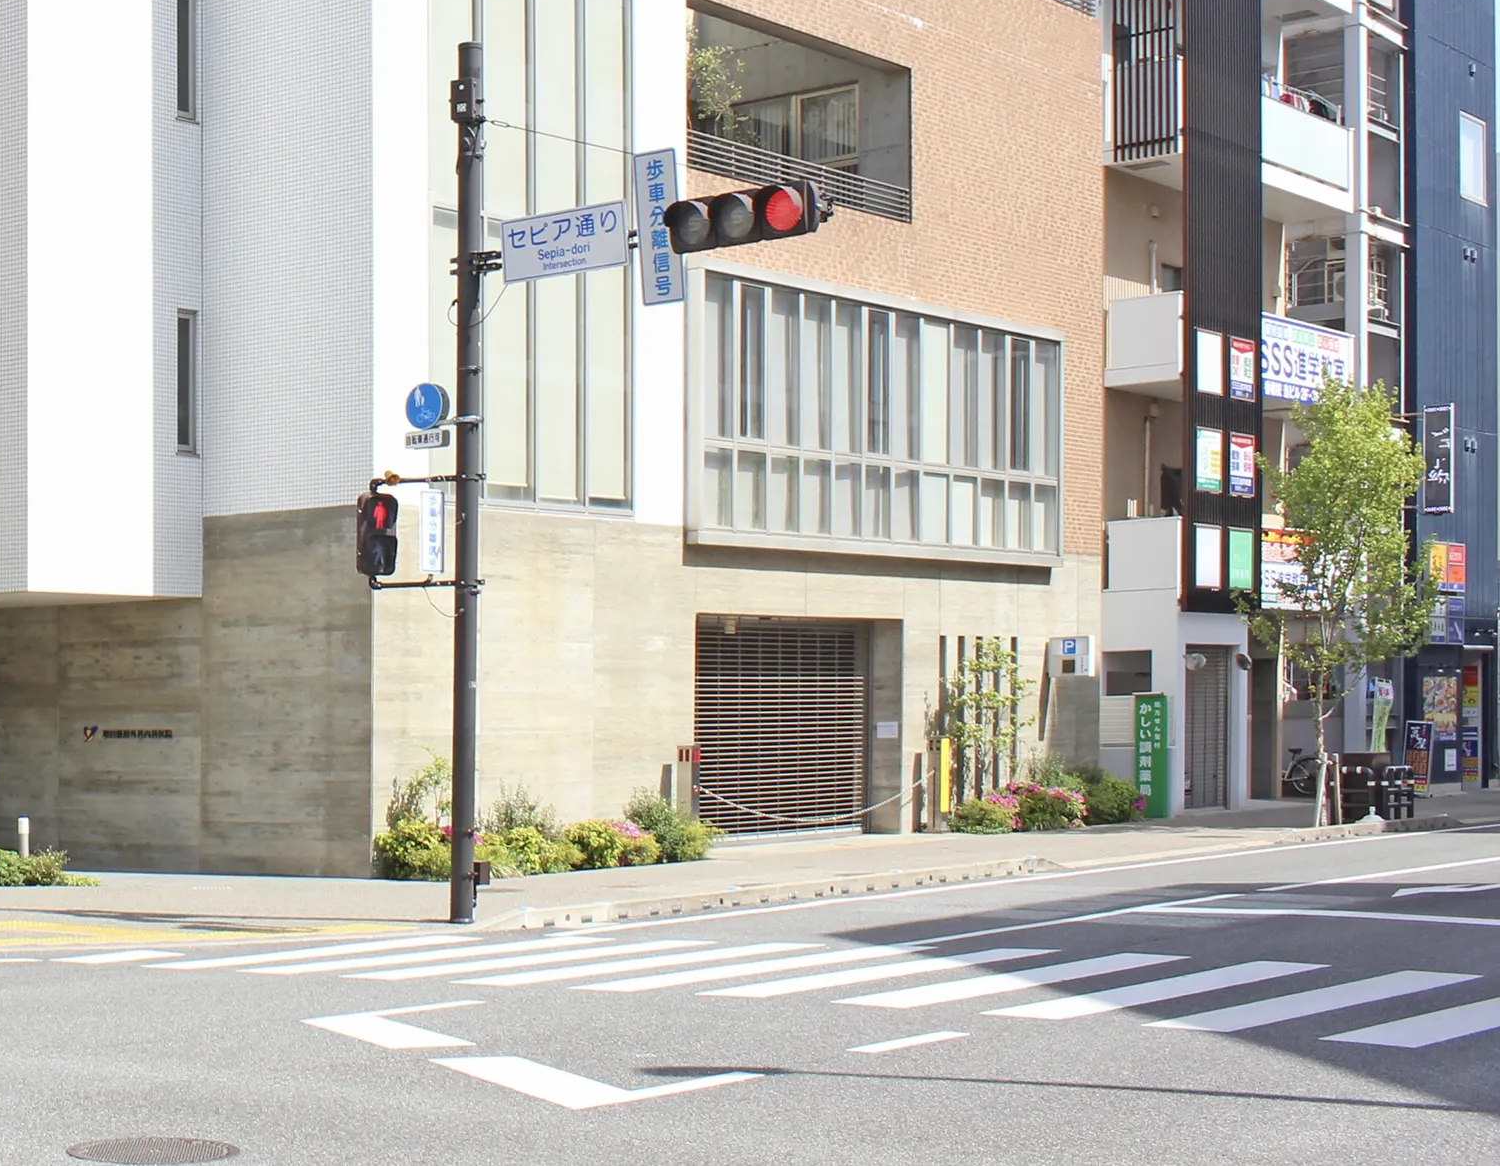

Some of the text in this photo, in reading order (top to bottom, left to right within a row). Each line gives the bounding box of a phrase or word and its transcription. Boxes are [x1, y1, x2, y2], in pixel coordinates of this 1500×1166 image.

[508, 209, 618, 249] セピア通り
[646, 158, 672, 297] 歩車分離信号
[537, 241, 591, 261] Sepia-dori
[543, 257, 587, 271] Intersection
[1064, 640, 1075, 654] P
